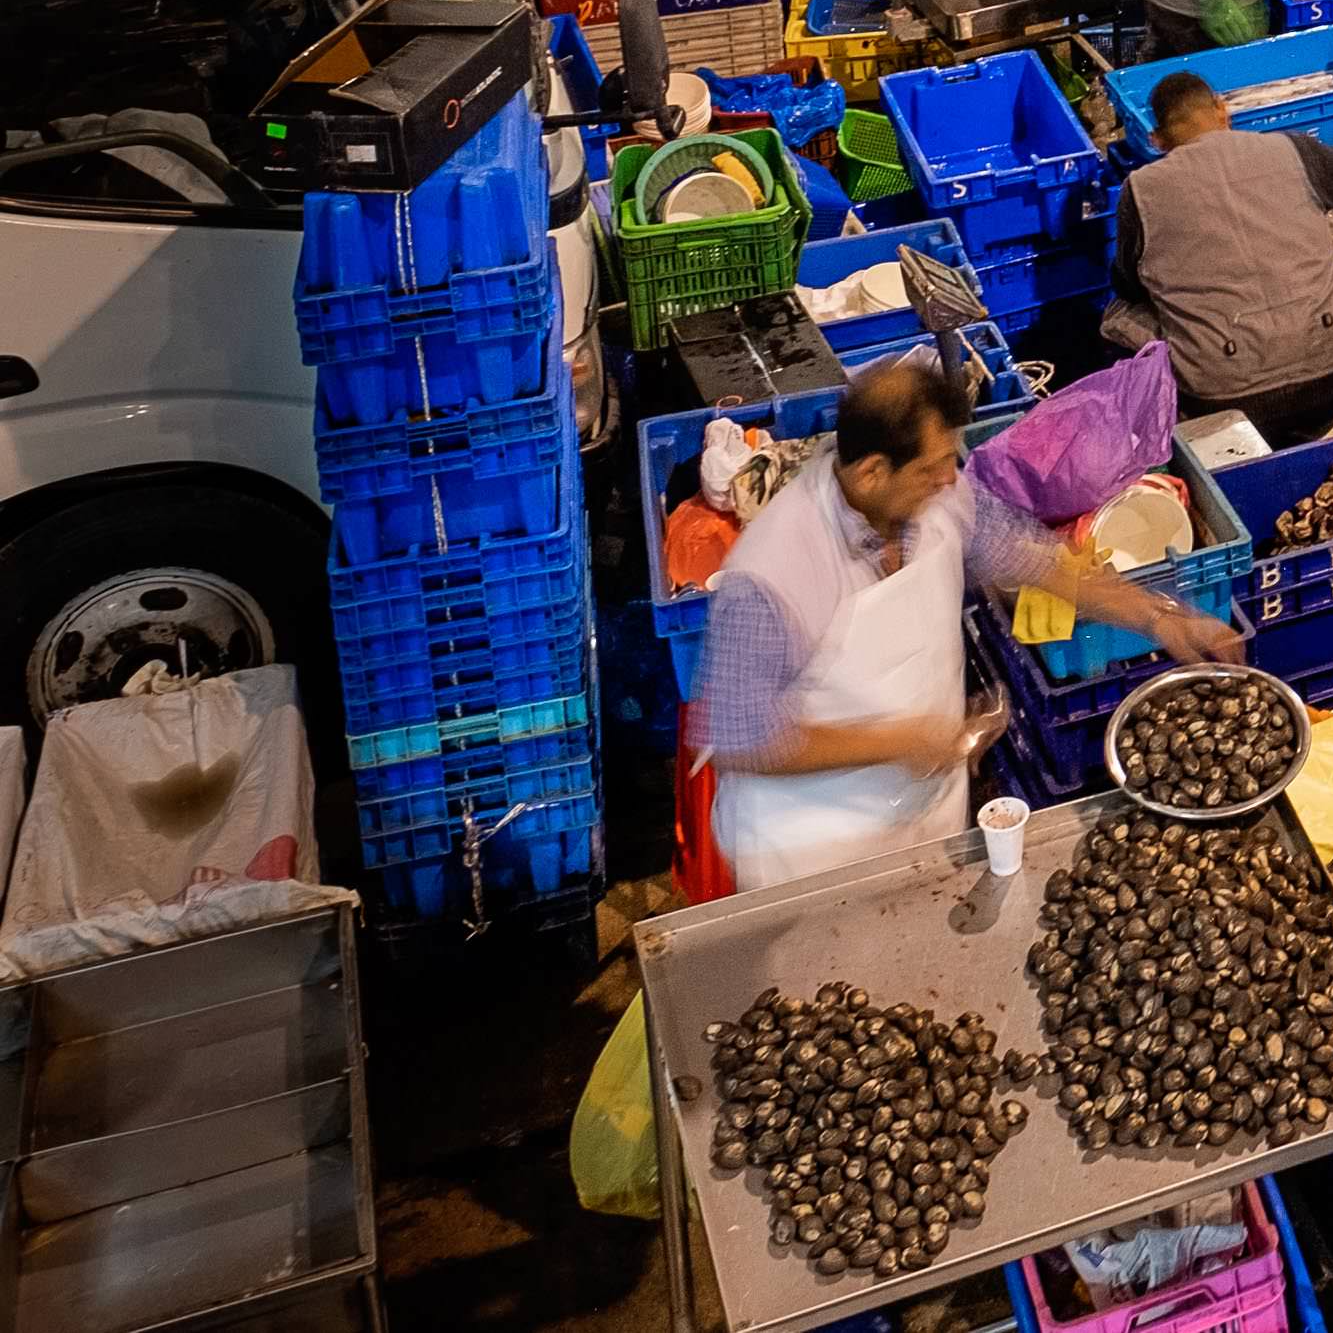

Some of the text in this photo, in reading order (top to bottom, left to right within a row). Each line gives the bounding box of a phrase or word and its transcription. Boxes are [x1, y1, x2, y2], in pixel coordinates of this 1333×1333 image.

[1310, 2, 1323, 21] S
[952, 181, 967, 199] S
[1260, 562, 1282, 590] B
[1261, 593, 1284, 621] B
